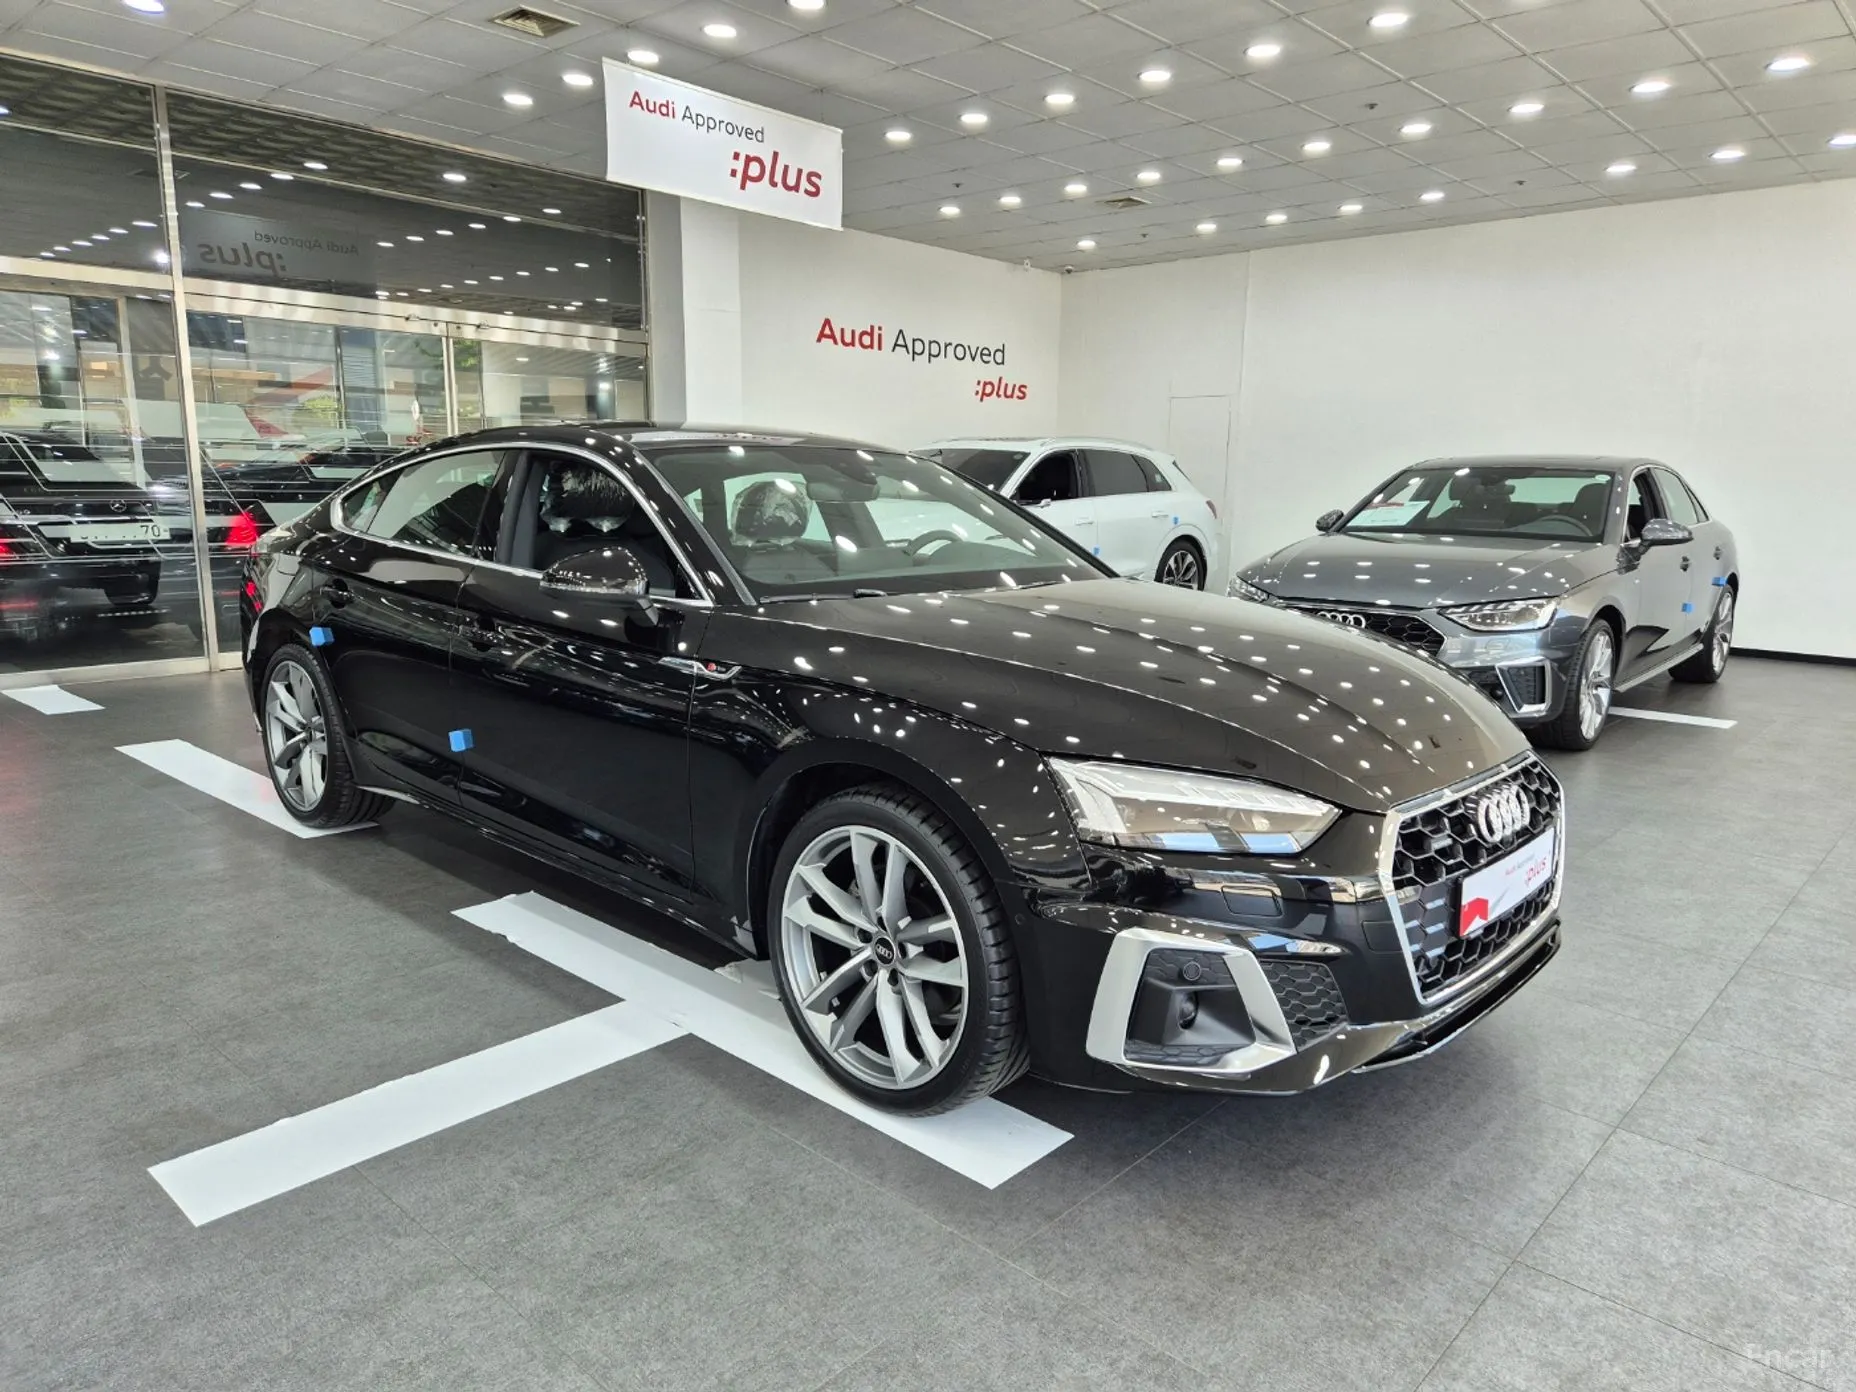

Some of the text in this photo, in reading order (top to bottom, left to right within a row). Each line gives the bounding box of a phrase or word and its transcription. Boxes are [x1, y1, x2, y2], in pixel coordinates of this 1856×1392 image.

[629, 91, 765, 143] Audi Approved
[729, 150, 823, 199] :plus
[816, 318, 1006, 366] Audi Approved
[974, 376, 1028, 402] :plus
